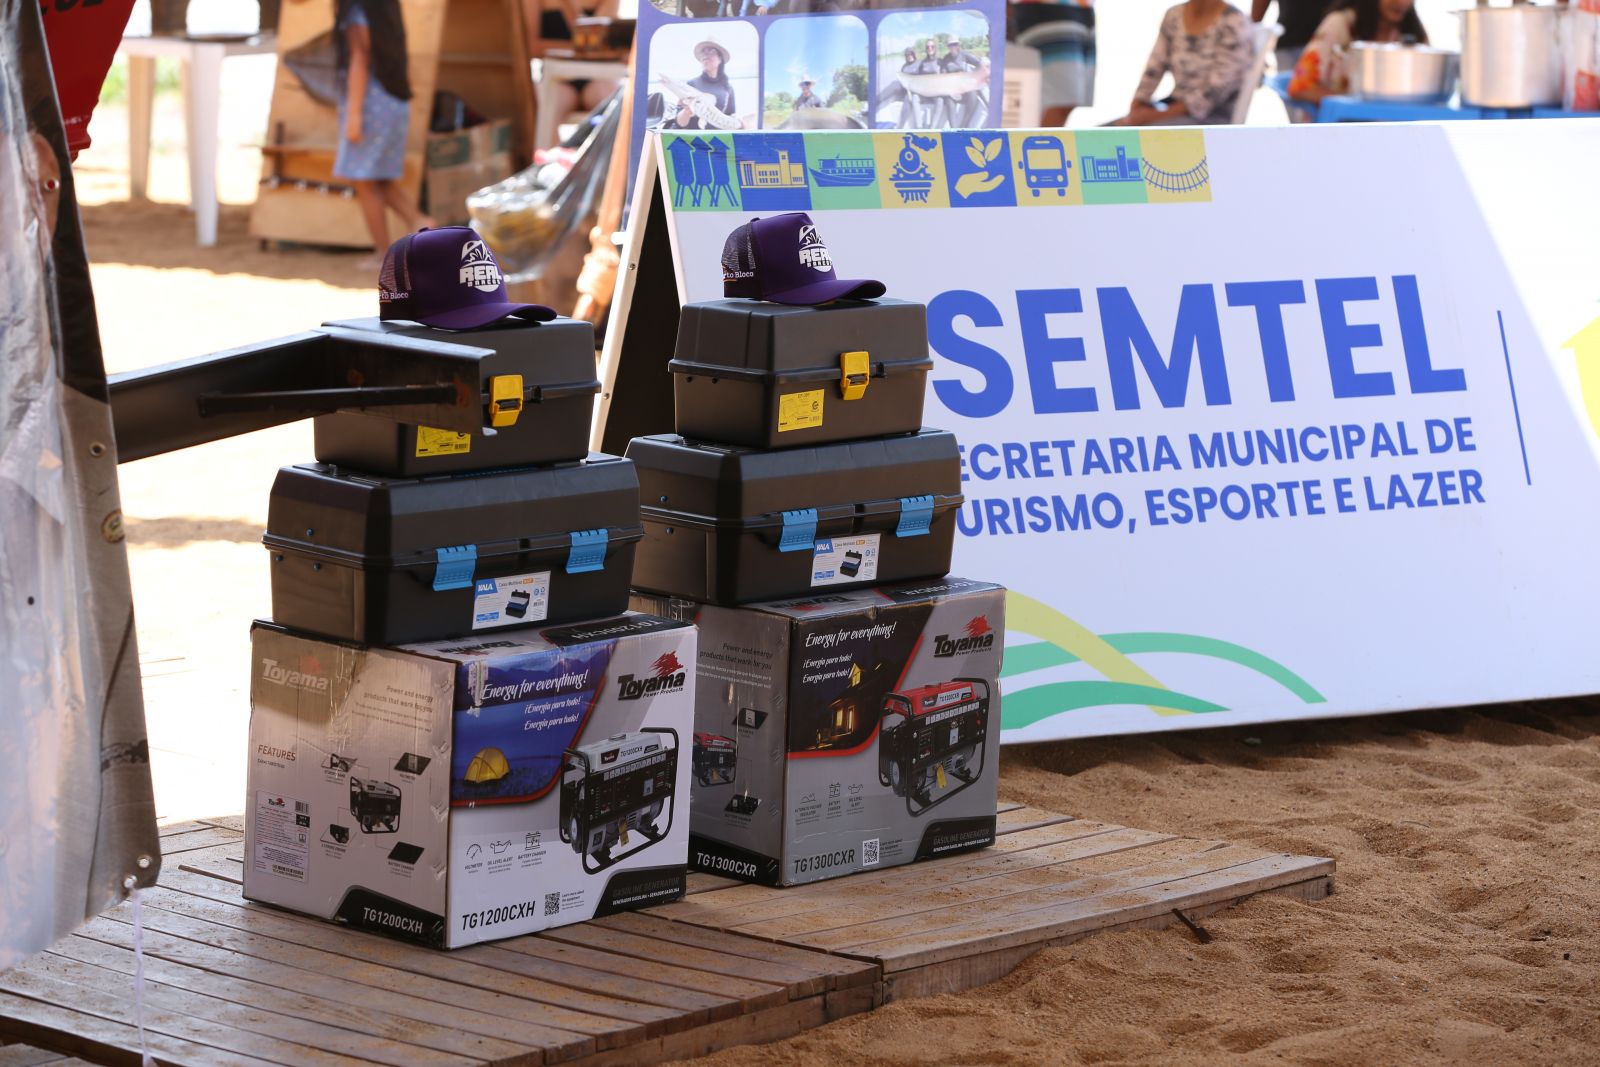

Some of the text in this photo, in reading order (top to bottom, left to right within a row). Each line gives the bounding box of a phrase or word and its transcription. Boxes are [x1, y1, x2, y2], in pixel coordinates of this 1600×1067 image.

[460, 265, 502, 284] REAL
[926, 274, 1467, 418] SEMTEL
[959, 417, 1476, 481] ECRETARIA MUNICIPAL DE
[957, 469, 1486, 537] URISMO, ESPORTE E LAZER
[805, 621, 897, 648] Energy for everything!
[934, 634, 994, 658] Toyama
[700, 651, 725, 660] products
[723, 643, 740, 652] Power
[753, 650, 773, 659] energy
[263, 658, 328, 690] Toyama
[481, 669, 589, 701] Energy for everything!
[618, 672, 685, 701] Toyama
[660, 687, 684, 695] Products
[257, 744, 296, 761] FEATURES
[696, 852, 757, 878] TG1300CXR
[794, 849, 855, 875] TG1300CXR
[363, 907, 424, 934] TG1200CXH
[461, 900, 536, 930] TG1200CXH
